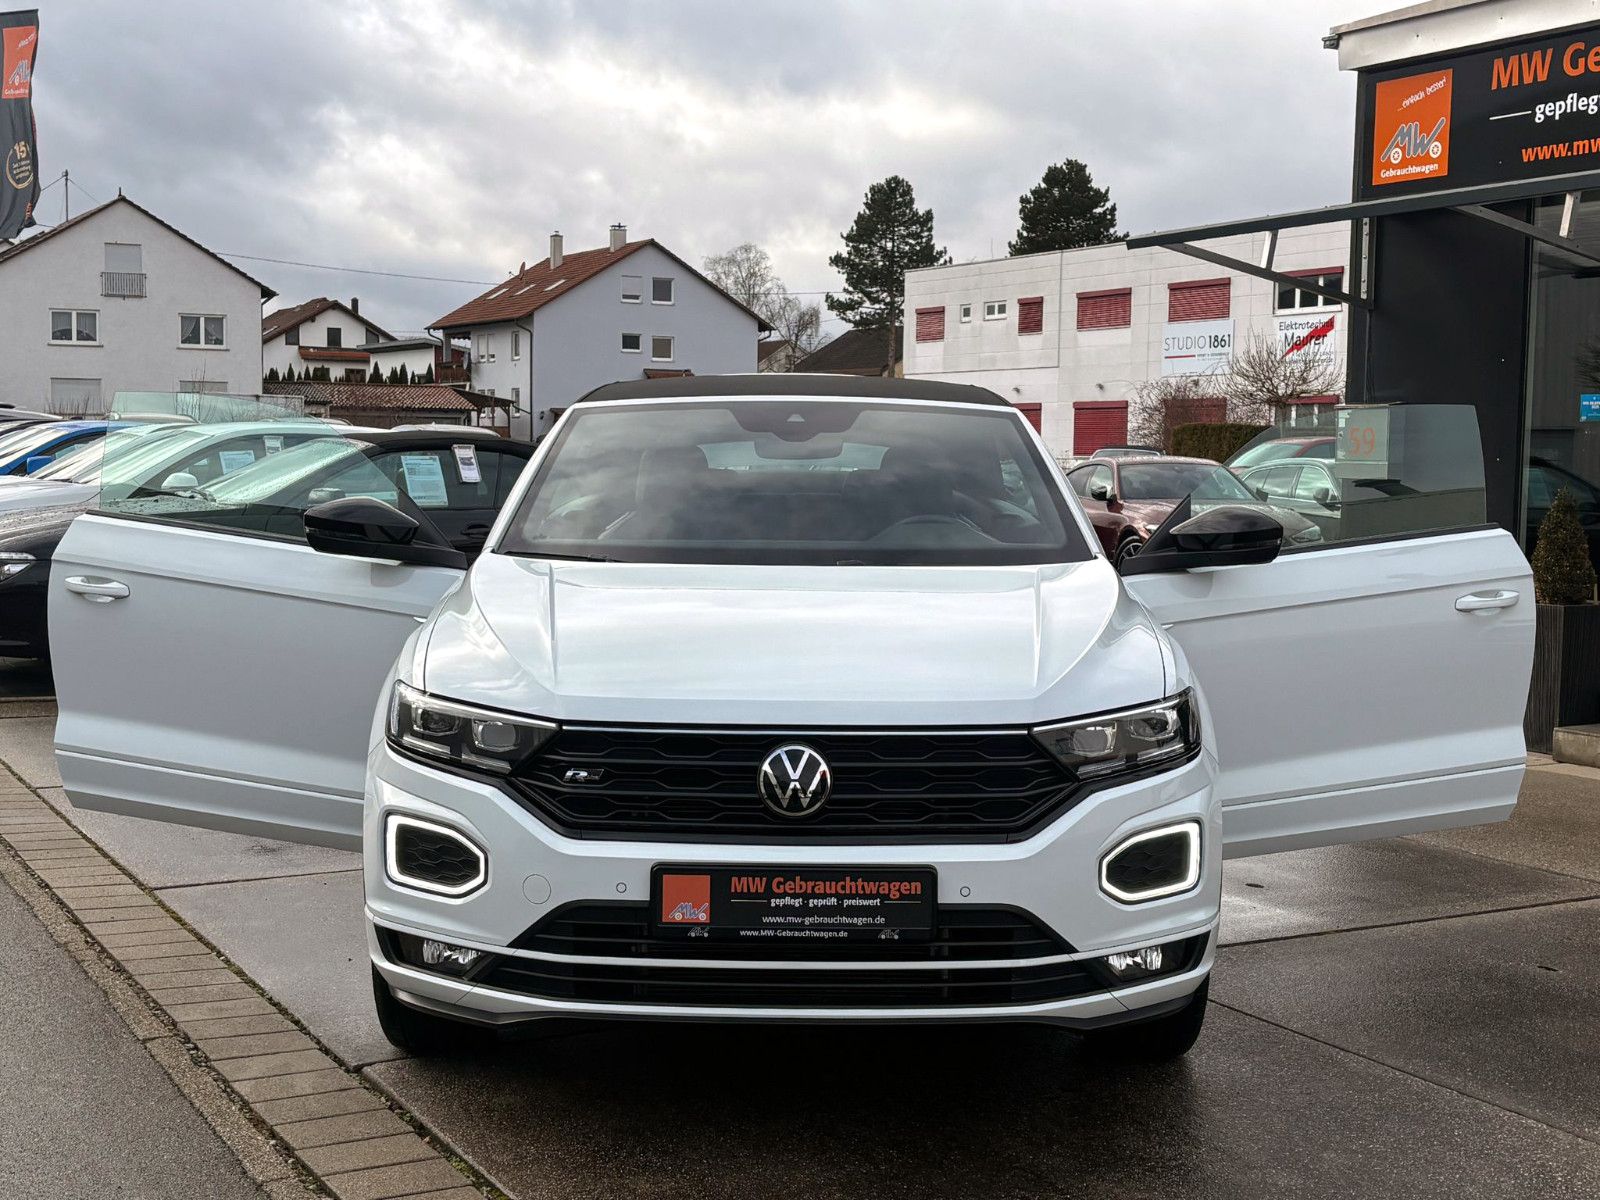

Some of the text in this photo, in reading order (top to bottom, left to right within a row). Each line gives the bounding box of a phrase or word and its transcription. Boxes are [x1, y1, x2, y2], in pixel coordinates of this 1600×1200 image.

[1491, 46, 1553, 91] MW
[1534, 92, 1600, 123] gepfleg
[1380, 163, 1439, 178] Gebrauchtwagen
[1284, 332, 1328, 348] Maurer
[730, 876, 922, 899] MW Gebrauchtwagen
[770, 896, 881, 908] gepflegt geprüft preiswert
[762, 914, 886, 926] www.mw-gebrauchtwagen.de
[739, 929, 848, 939] www.MW-Gebrauchtwagen.de
